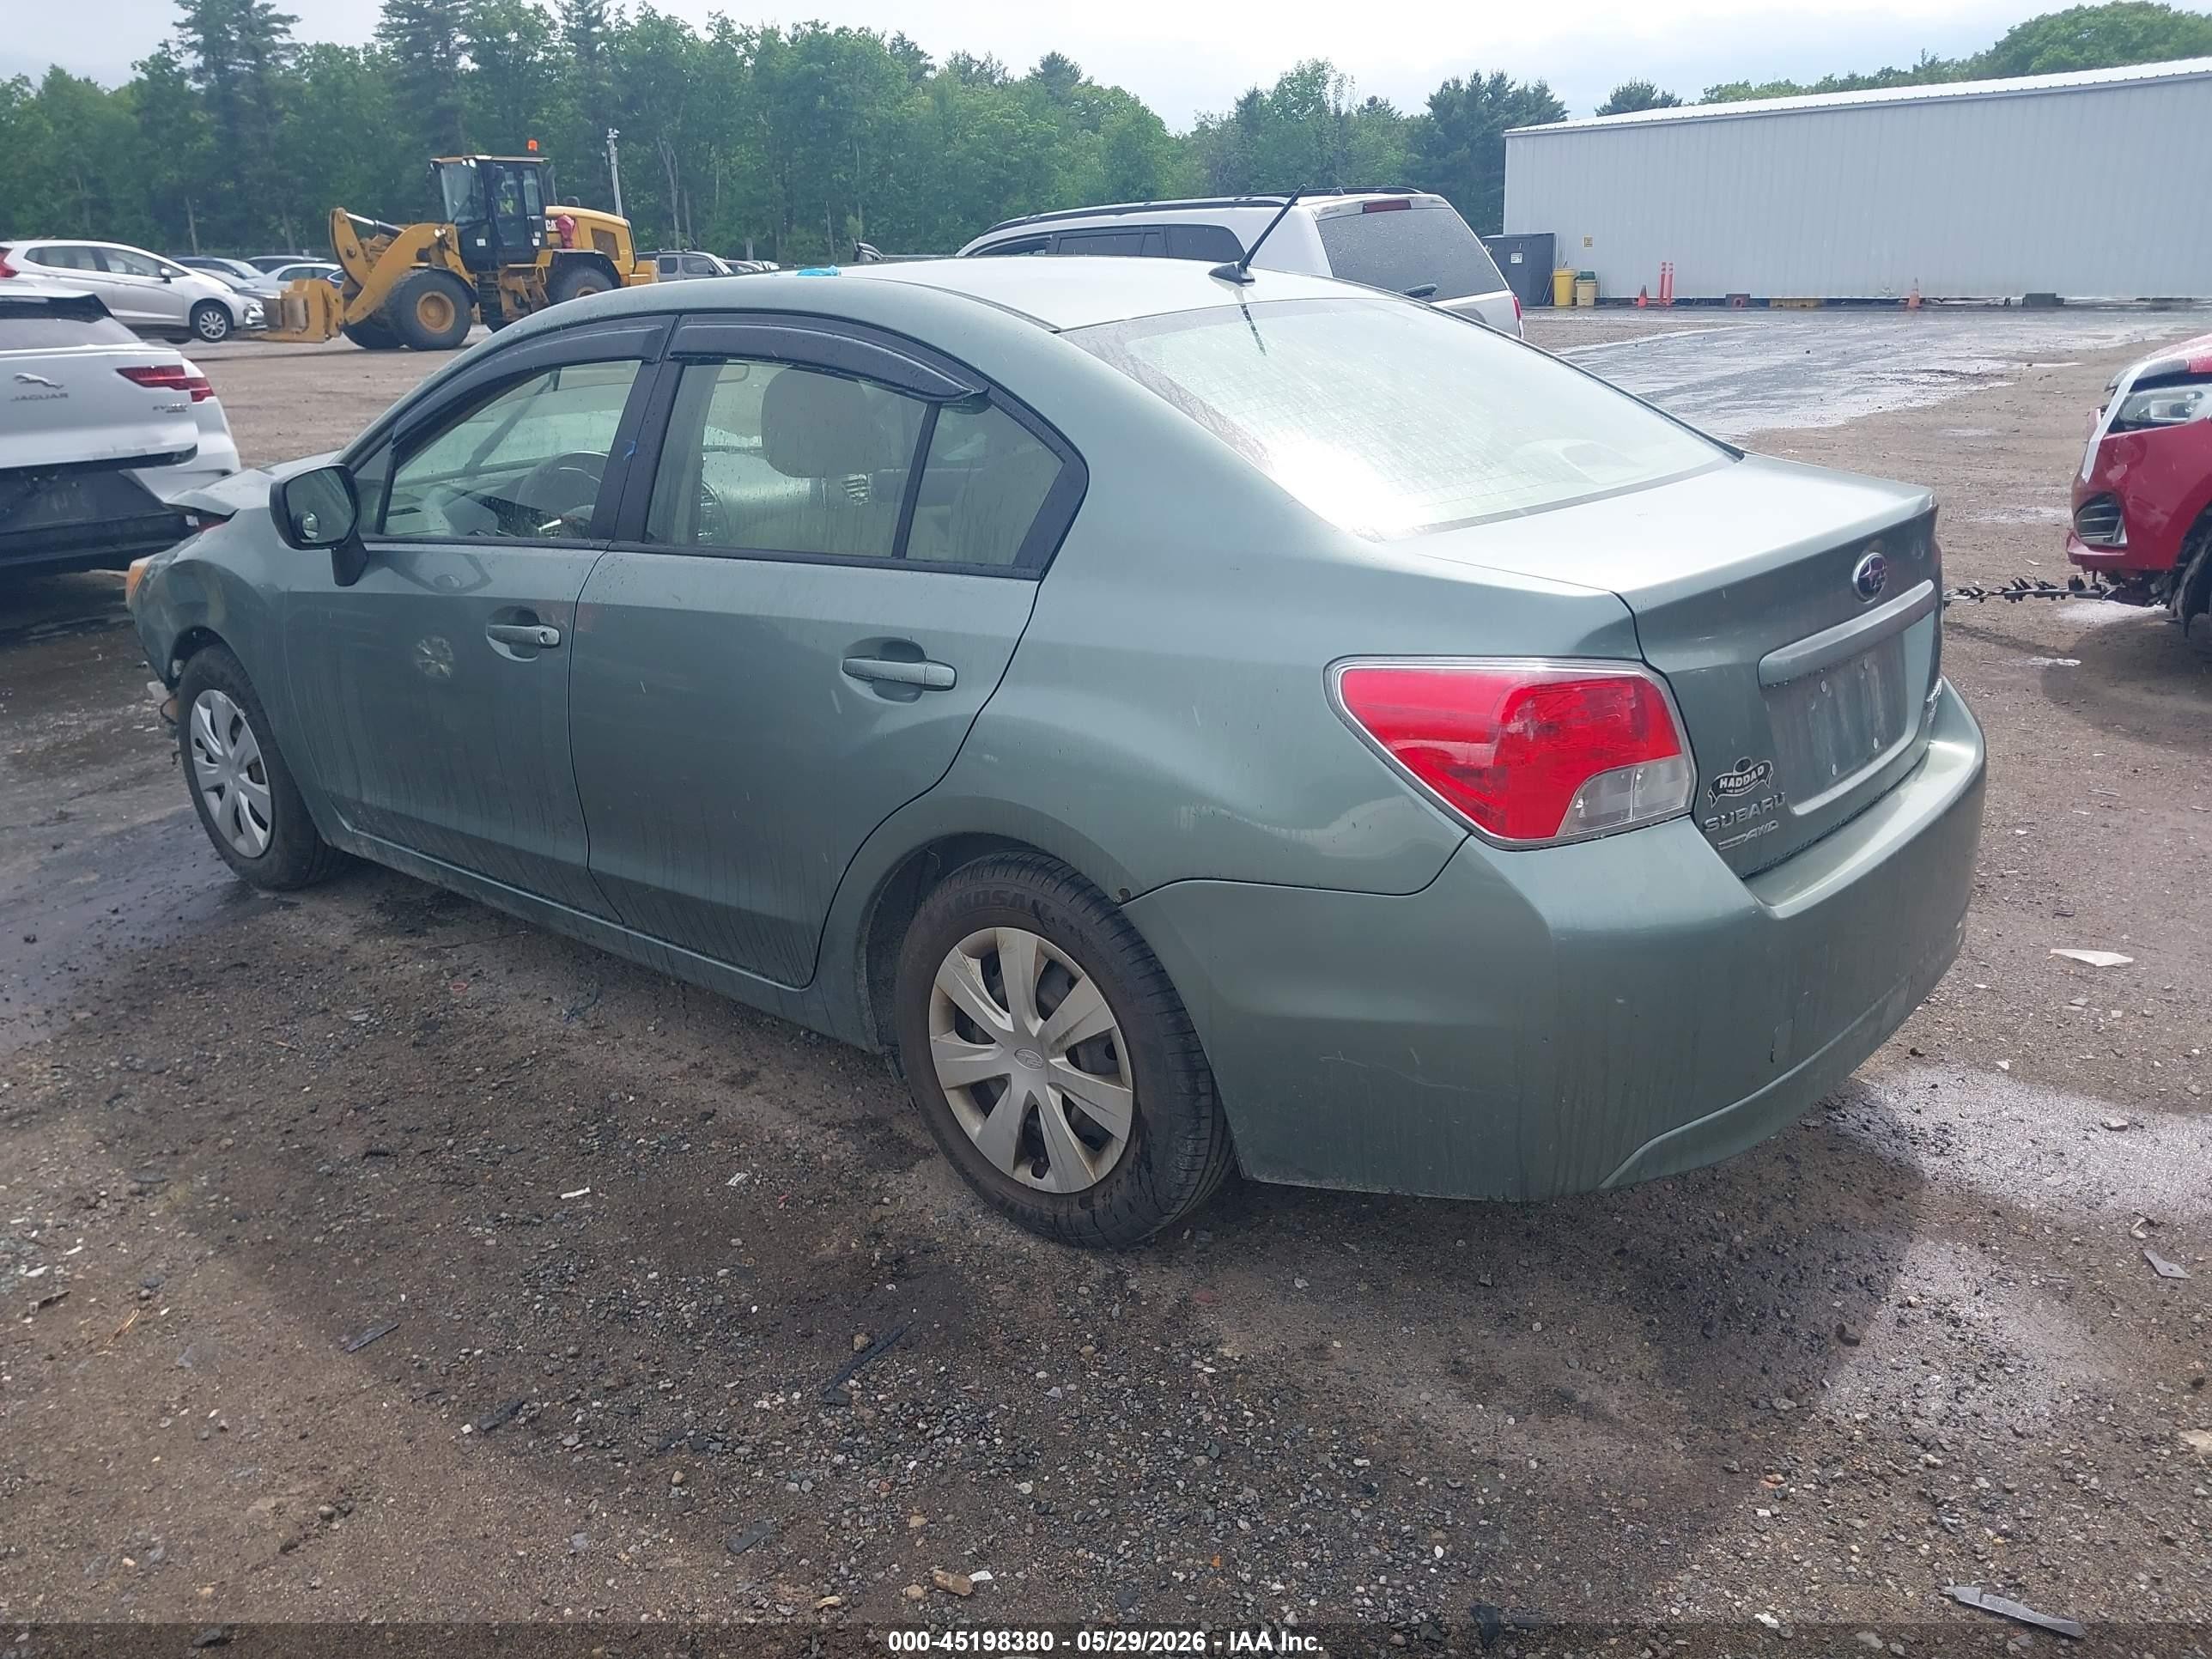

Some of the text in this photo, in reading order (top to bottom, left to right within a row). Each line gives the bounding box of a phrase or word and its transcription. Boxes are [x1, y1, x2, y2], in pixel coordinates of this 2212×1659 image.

[544, 219, 558, 231] CA
[9, 392, 70, 402] JAGUAR
[1719, 764, 1765, 789] HADDAD
[1703, 792, 1786, 832] SUBARU
